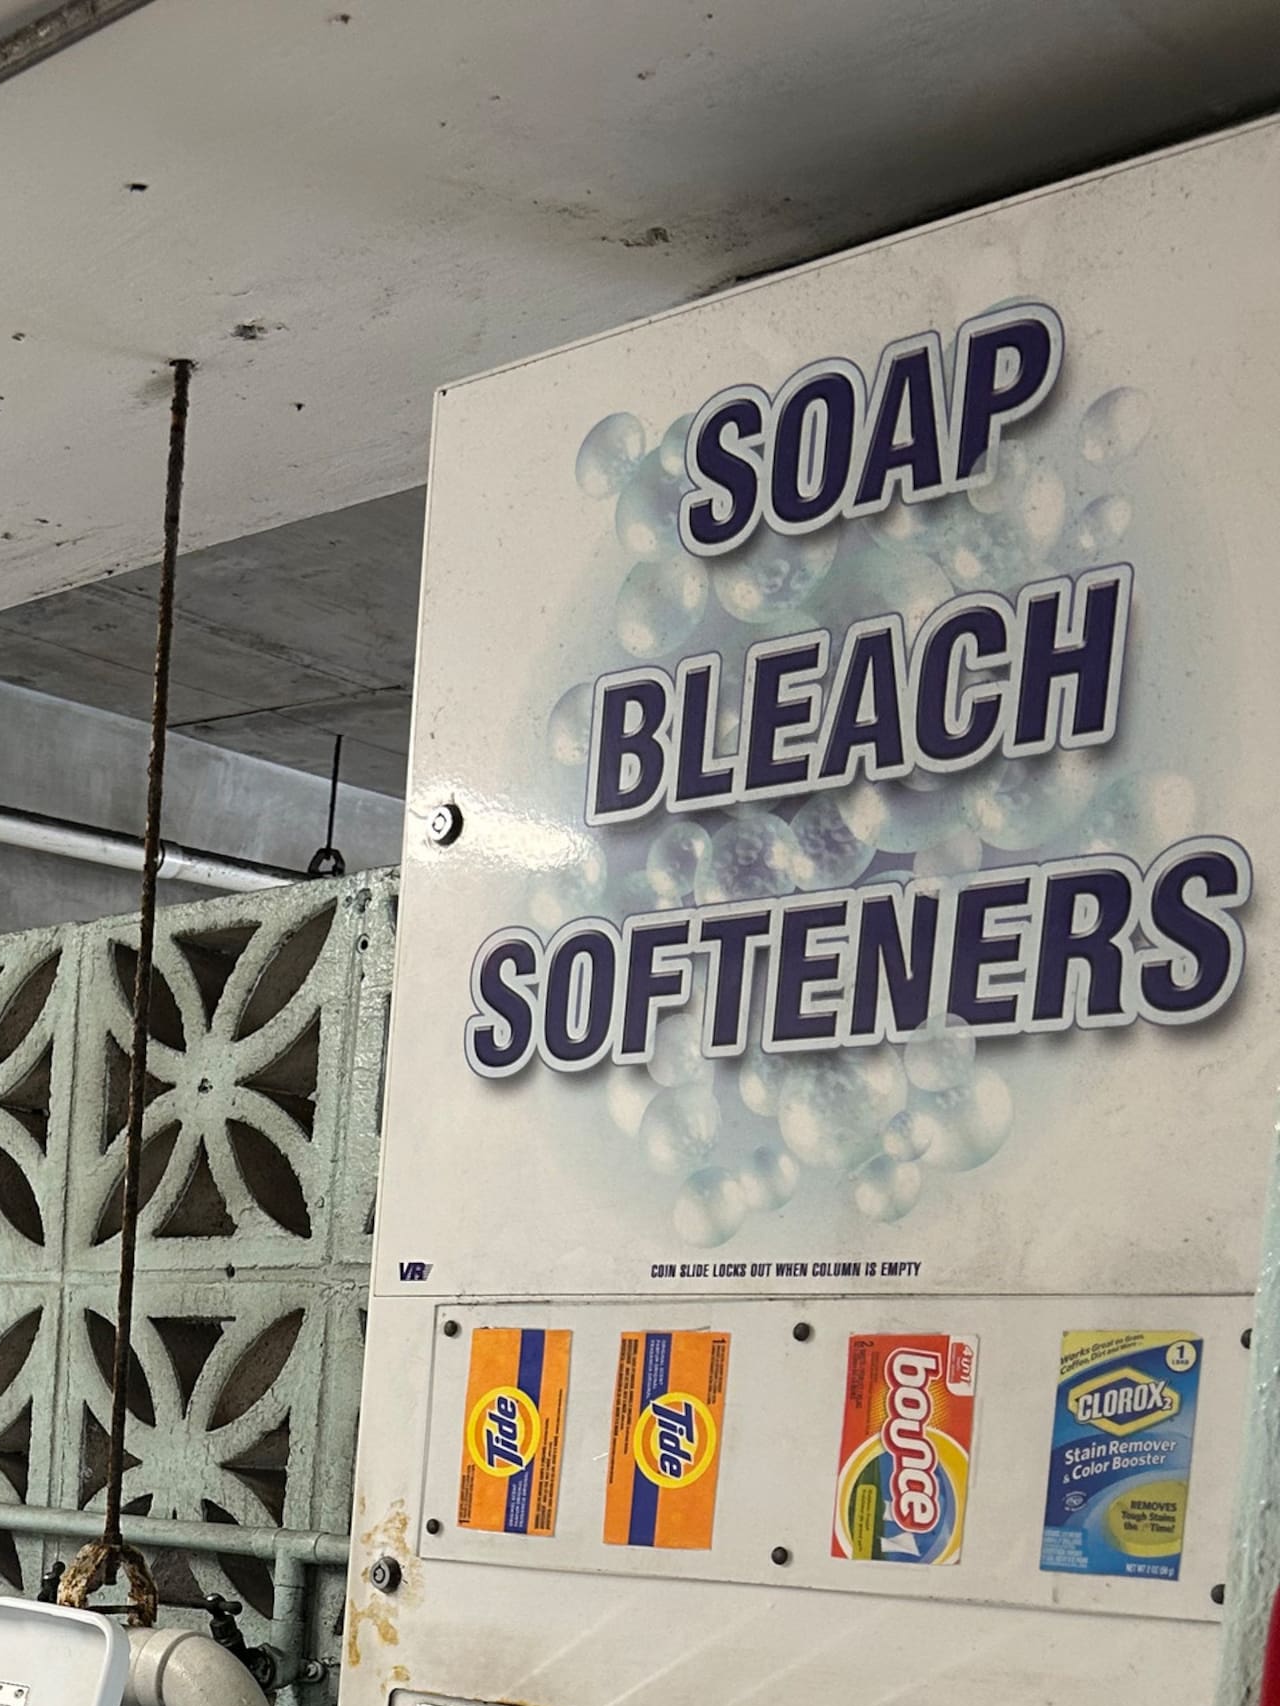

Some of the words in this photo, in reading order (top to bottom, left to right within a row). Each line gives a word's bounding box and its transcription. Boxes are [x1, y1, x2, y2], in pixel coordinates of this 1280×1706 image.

[685, 312, 1056, 550] SOAP
[591, 573, 1128, 820] BLEACH
[469, 846, 1244, 1072] SOFTENERS
[651, 1264, 676, 1278] COIN
[680, 1264, 709, 1278] SLIDE
[713, 1263, 746, 1278] LOCKS
[750, 1263, 772, 1277] OUT
[776, 1263, 808, 1277] WHEN
[812, 1262, 861, 1277] COLUMN
[865, 1262, 877, 1276] IS
[880, 1262, 922, 1276] EMPTY
[1060, 1345, 1090, 1366] Works
[1091, 1339, 1114, 1353] Great
[1091, 1348, 1106, 1361] Dirt
[1176, 1344, 1185, 1360] 1
[1077, 1380, 1166, 1421] CLOROX
[485, 1395, 524, 1468] Tide
[651, 1401, 693, 1479] Tide
[886, 1350, 939, 1528] bounce
[1064, 1441, 1106, 1465] Stain
[1109, 1440, 1177, 1456] Remover
[1072, 1461, 1110, 1480] Color
[1112, 1453, 1166, 1470] Booster
[1121, 1510, 1147, 1523] Tough
[1130, 1500, 1177, 1512] REMOVES
